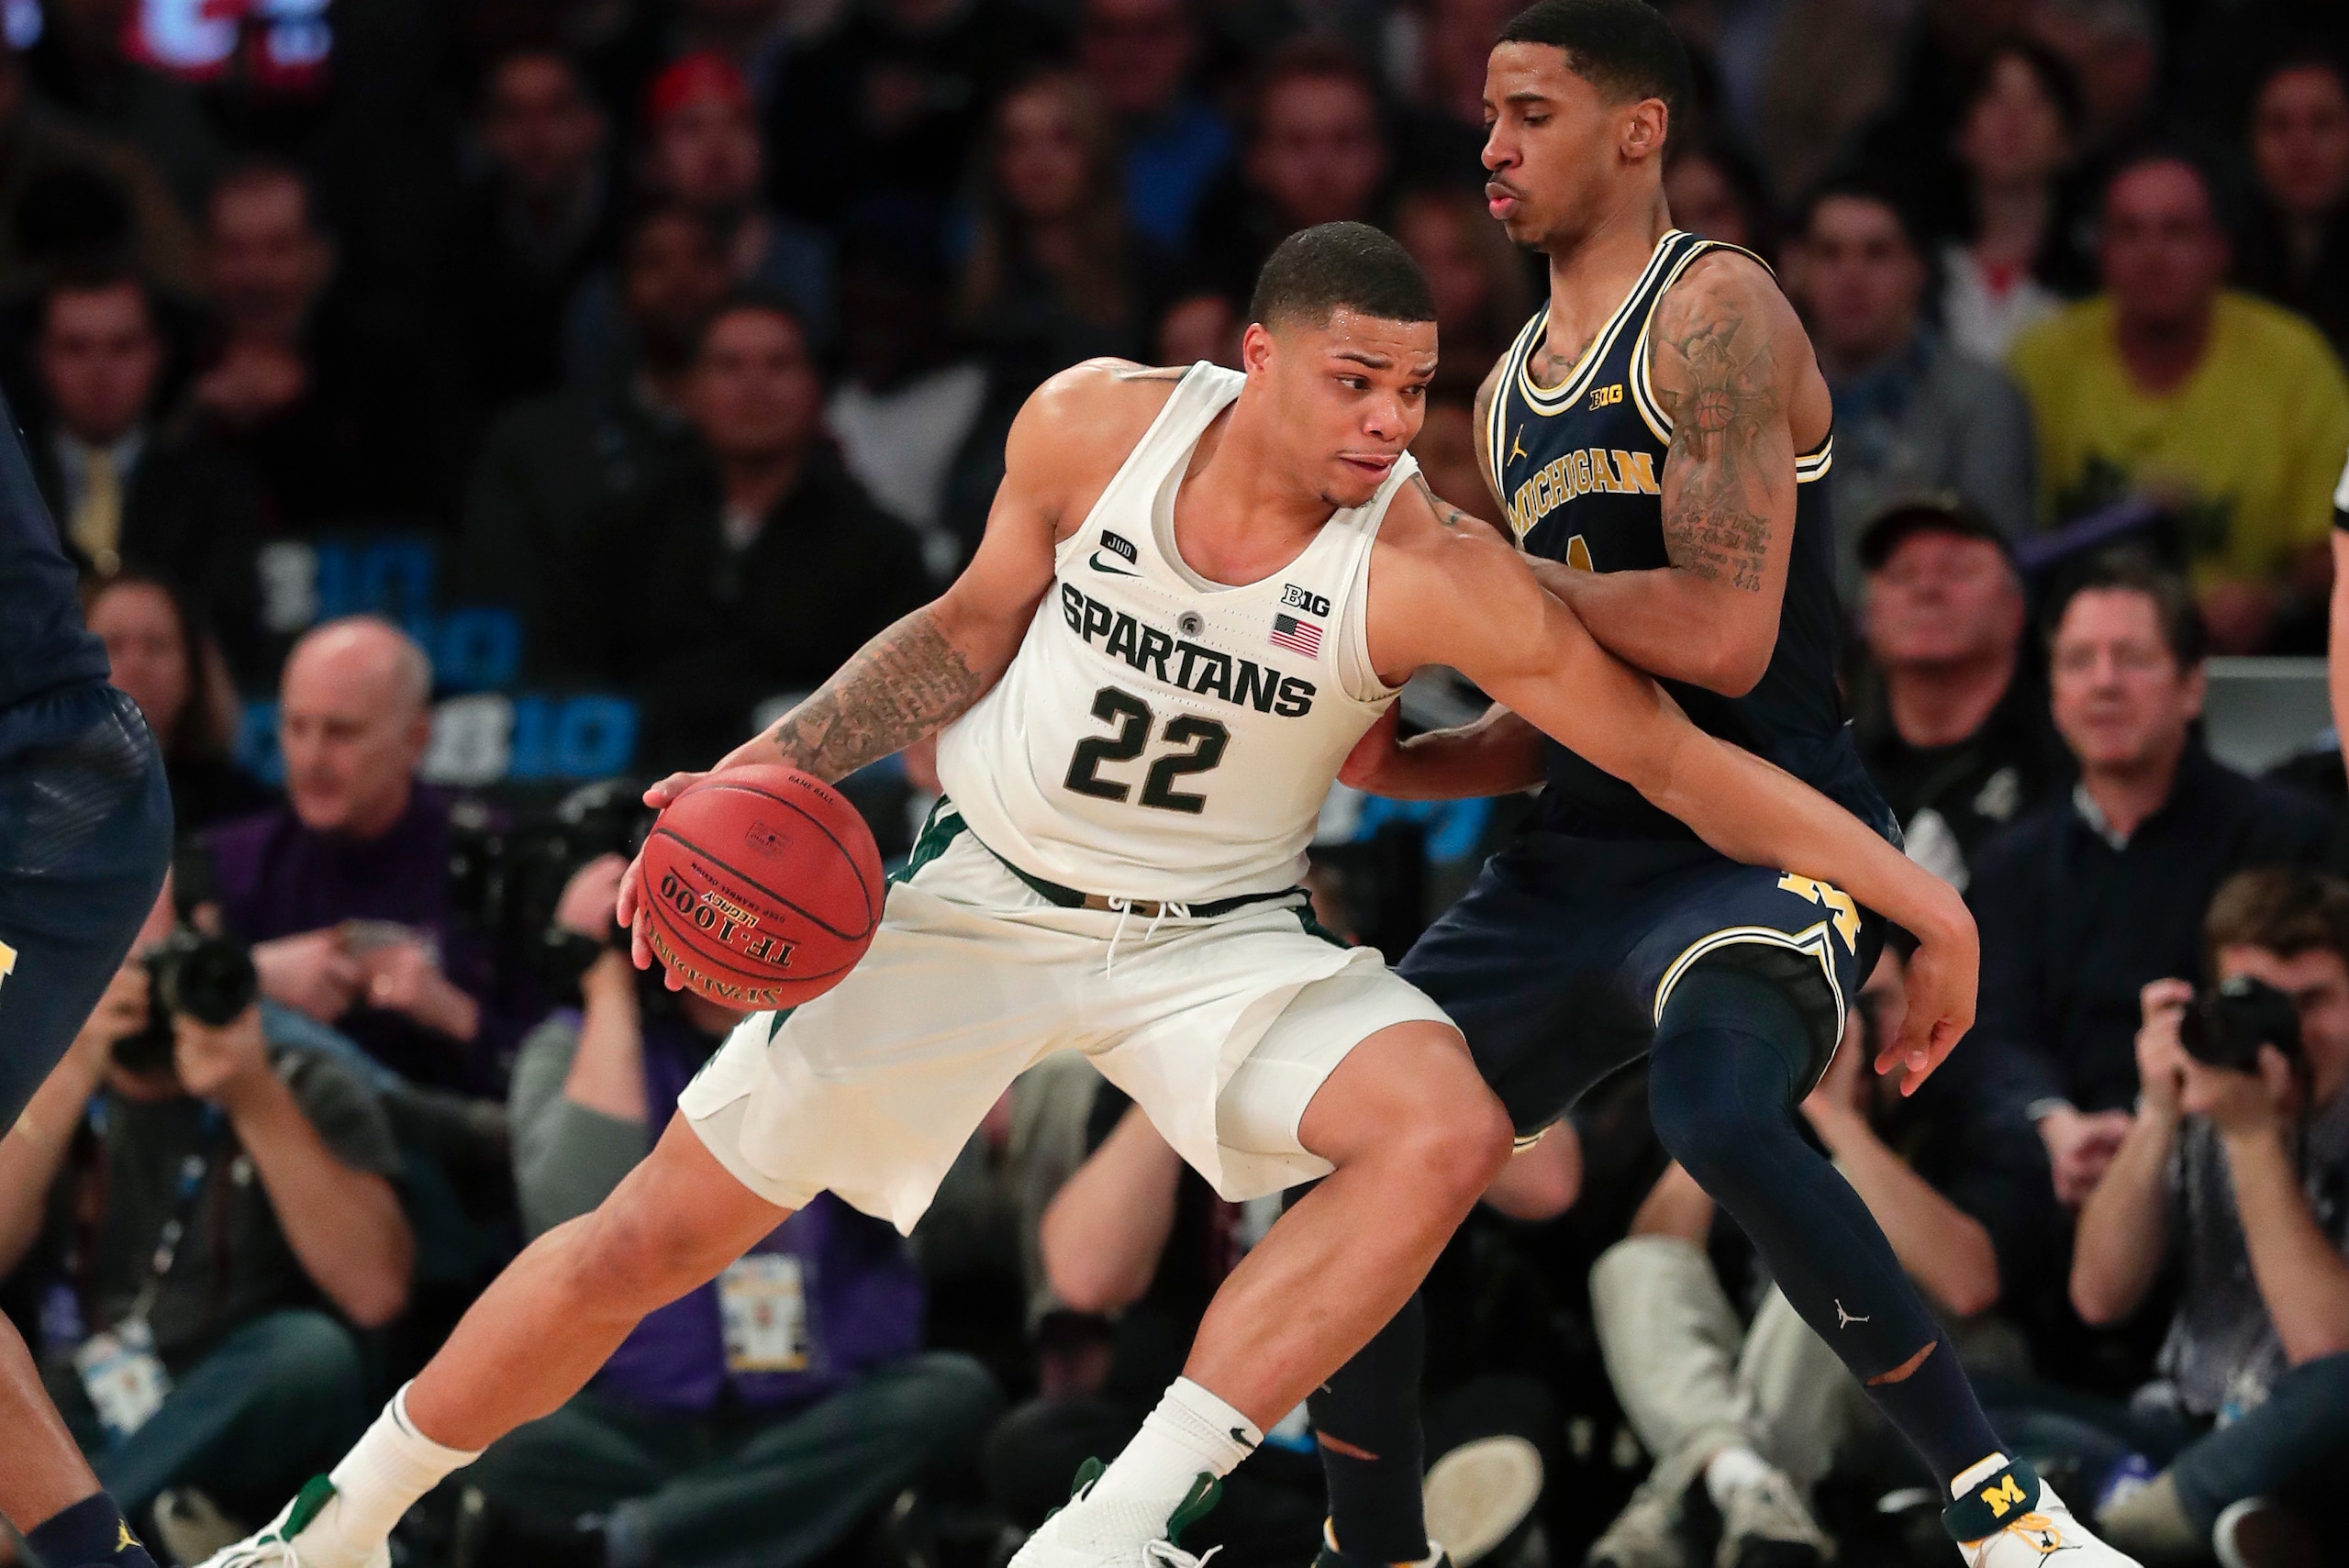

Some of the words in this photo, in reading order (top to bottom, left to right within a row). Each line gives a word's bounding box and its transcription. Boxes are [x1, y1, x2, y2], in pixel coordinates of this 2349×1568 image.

[1508, 448, 1662, 539] MICHIGAN
[1107, 537, 1132, 558] JUD
[1061, 582, 1318, 718] SPARTANS
[1063, 685, 1231, 815] 22
[661, 873, 796, 968] TF-1000
[700, 890, 761, 929] LEGACY
[1980, 1473, 2027, 1519] M
